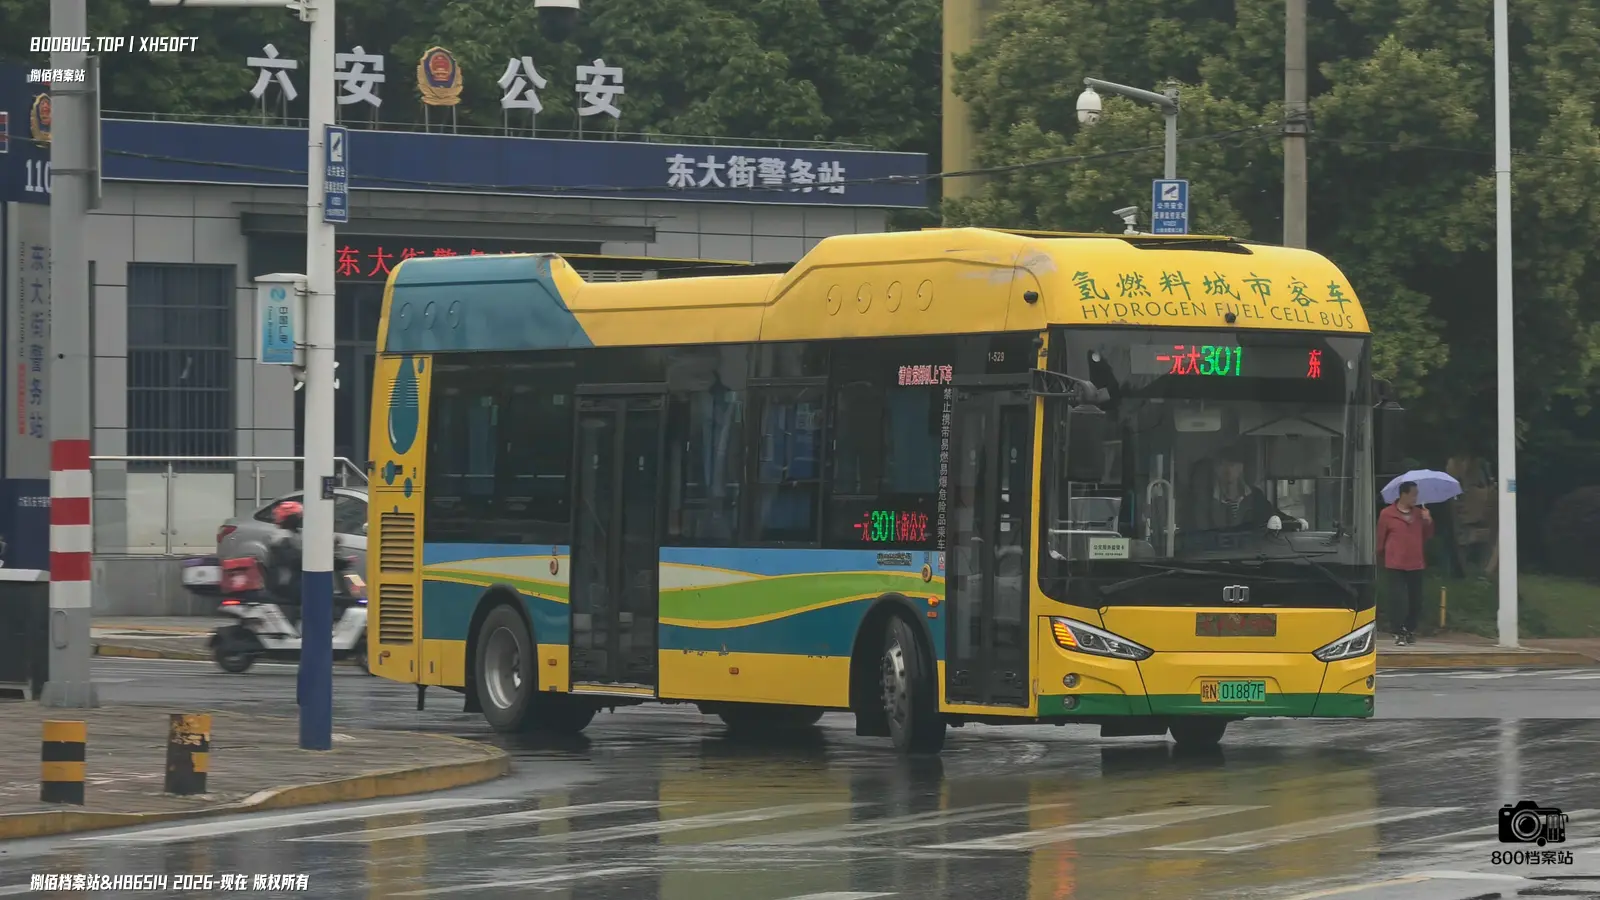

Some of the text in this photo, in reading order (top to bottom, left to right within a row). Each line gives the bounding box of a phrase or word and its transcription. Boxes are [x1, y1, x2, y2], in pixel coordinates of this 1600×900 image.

[665, 153, 846, 194] 东大街警务站
[1072, 270, 1353, 314] 氢燃料城市客车
[1082, 301, 1354, 329] HYDROGEN FUEL CELL BUS
[1306, 349, 1322, 379] 东
